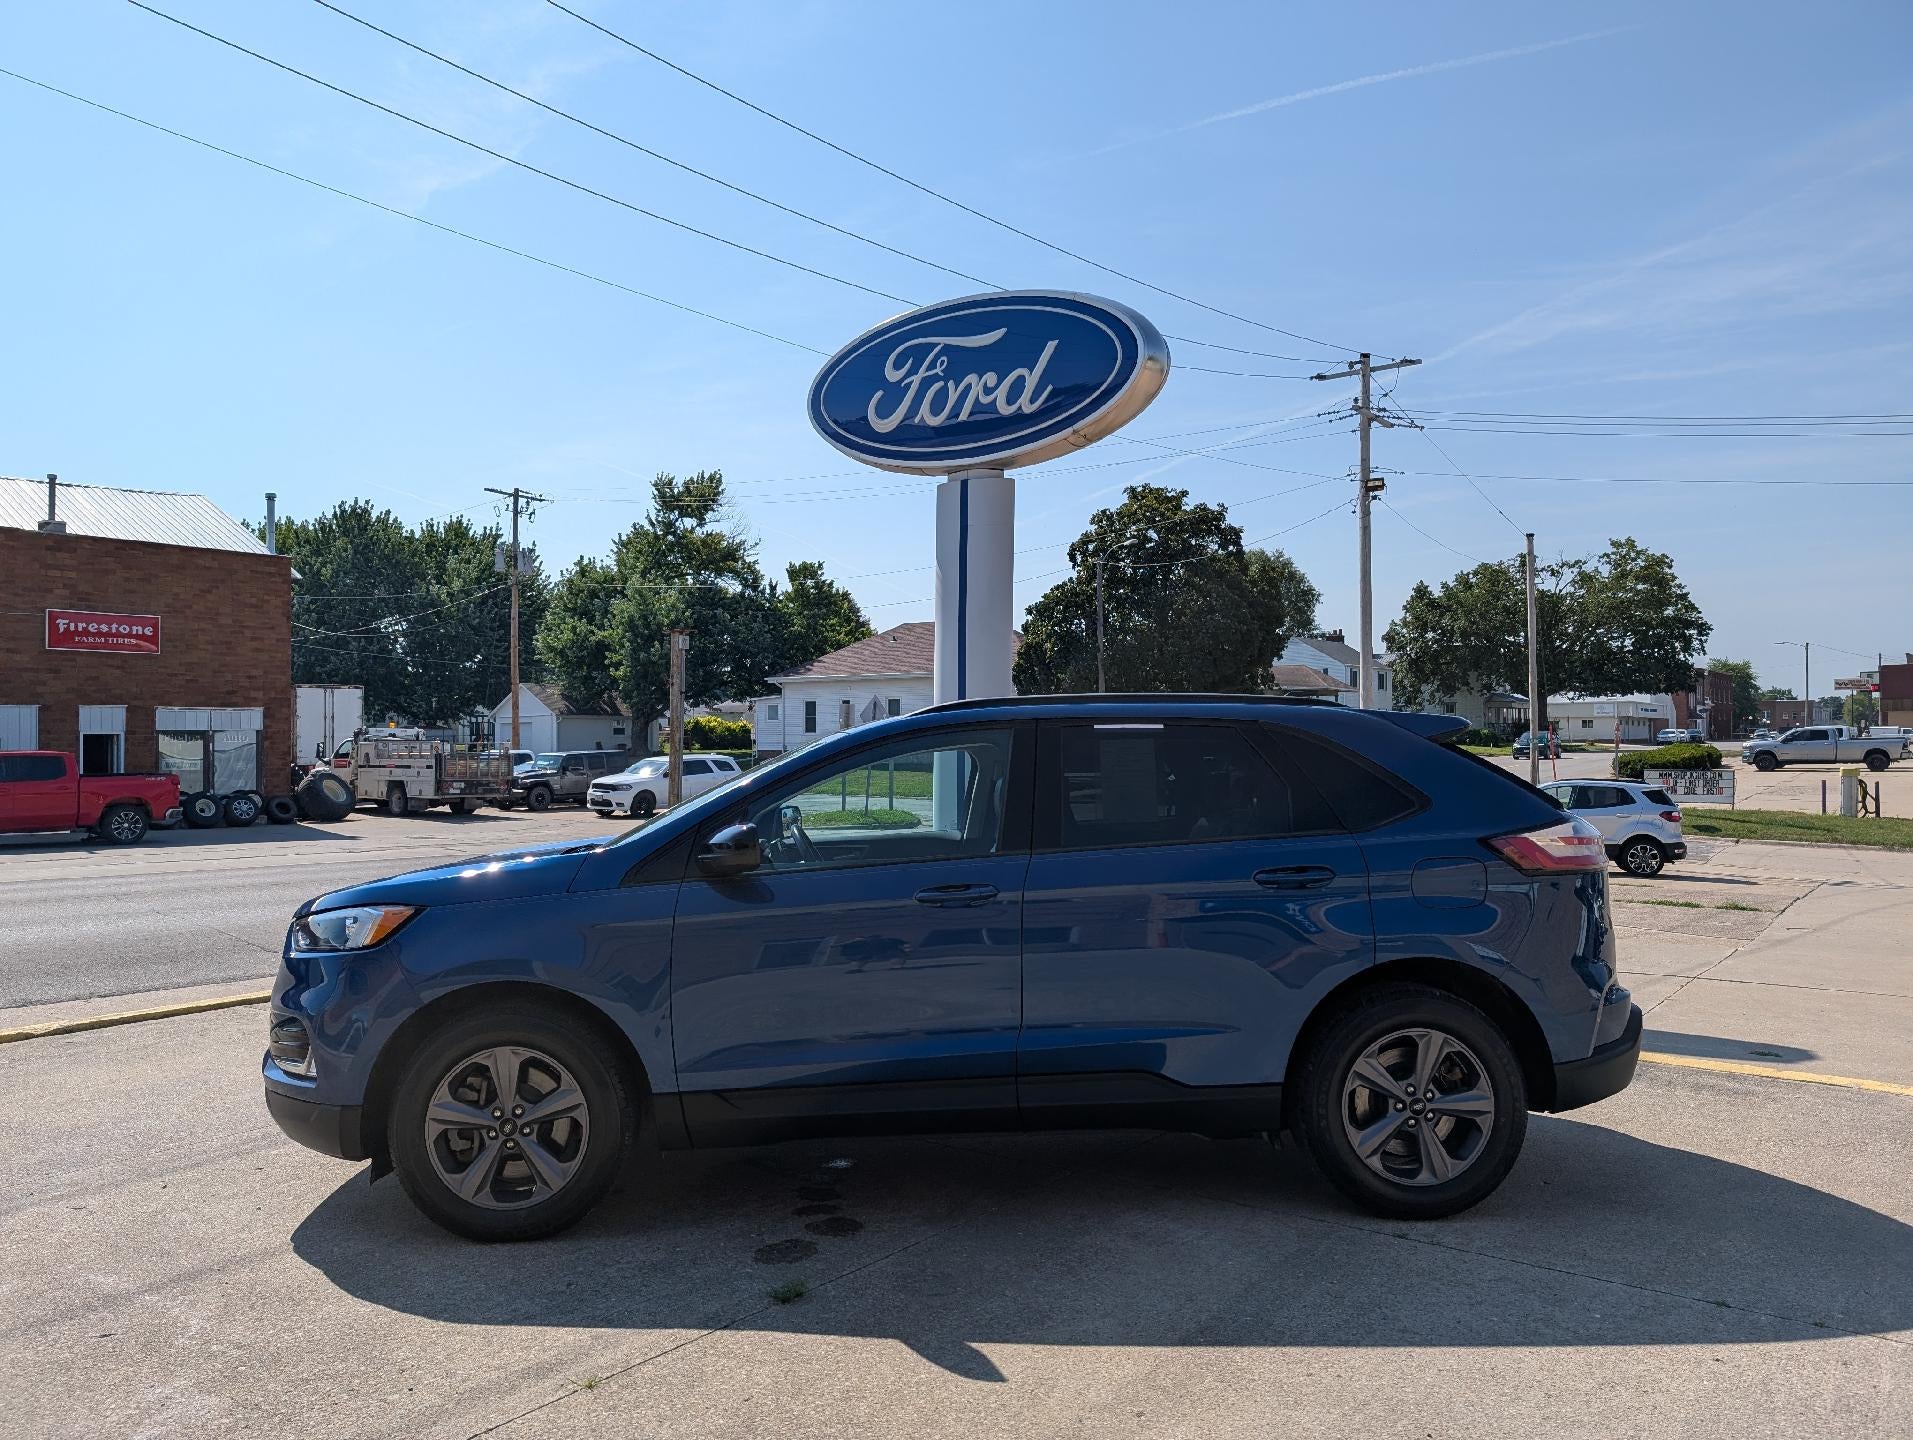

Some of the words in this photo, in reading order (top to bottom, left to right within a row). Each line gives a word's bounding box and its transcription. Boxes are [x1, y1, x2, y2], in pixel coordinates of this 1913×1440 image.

[867, 327, 1060, 433] Ford
[55, 618, 154, 636] Firestone
[106, 637, 137, 645] TIRES
[1684, 779, 1701, 788] FIRST
[1702, 779, 1720, 788] ORDER
